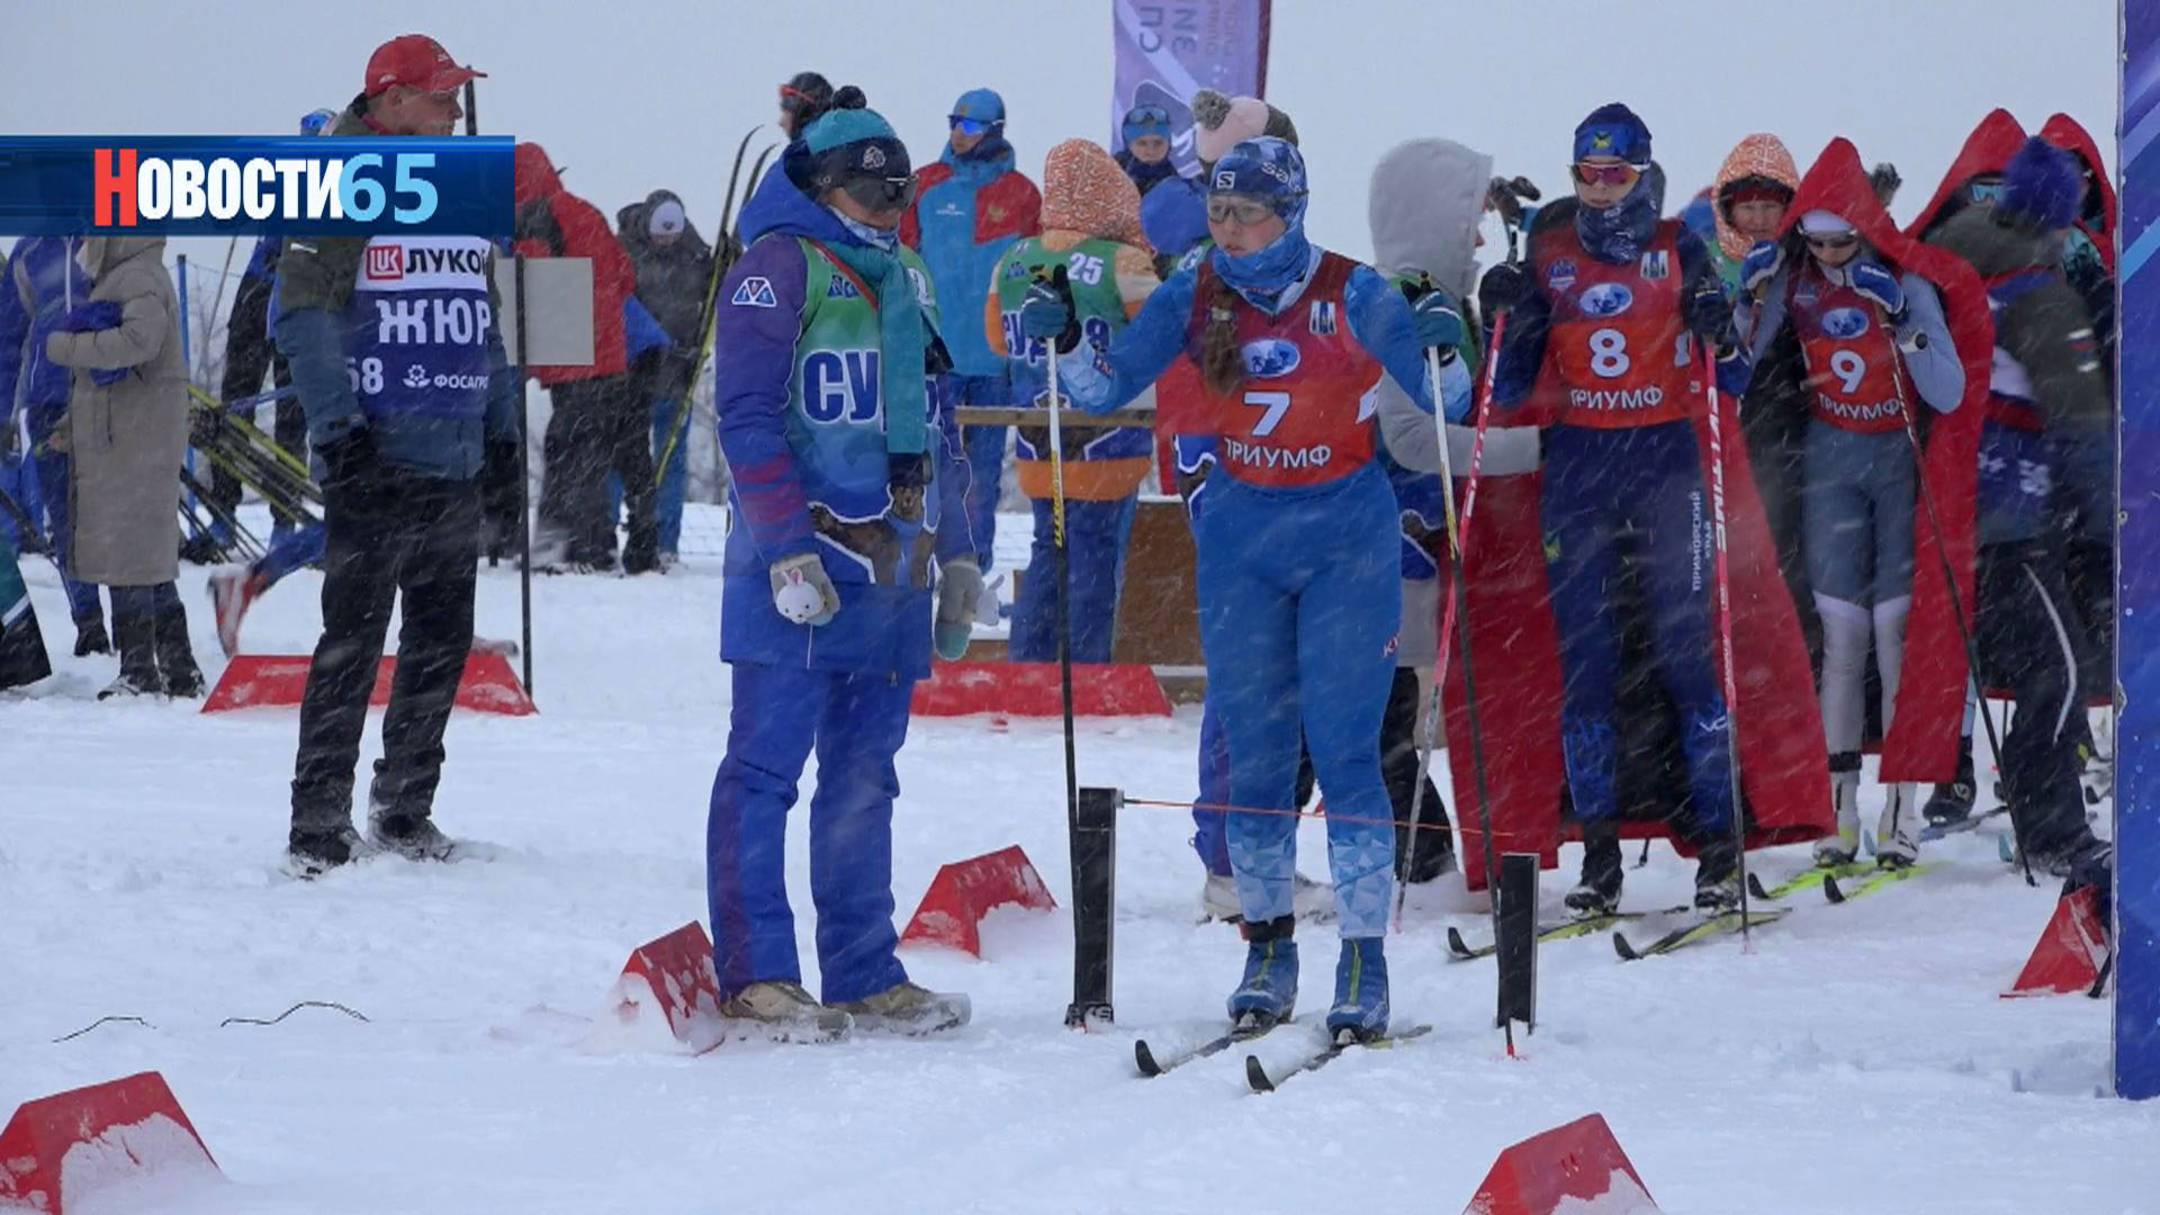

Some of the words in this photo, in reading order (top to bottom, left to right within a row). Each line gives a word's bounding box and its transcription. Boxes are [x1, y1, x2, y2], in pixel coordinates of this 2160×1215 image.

[1067, 252, 1105, 285] 25
[375, 297, 492, 345] ЖЮР
[1588, 328, 1631, 378] 8
[1830, 350, 1867, 394] 9
[1244, 391, 1292, 437] 7
